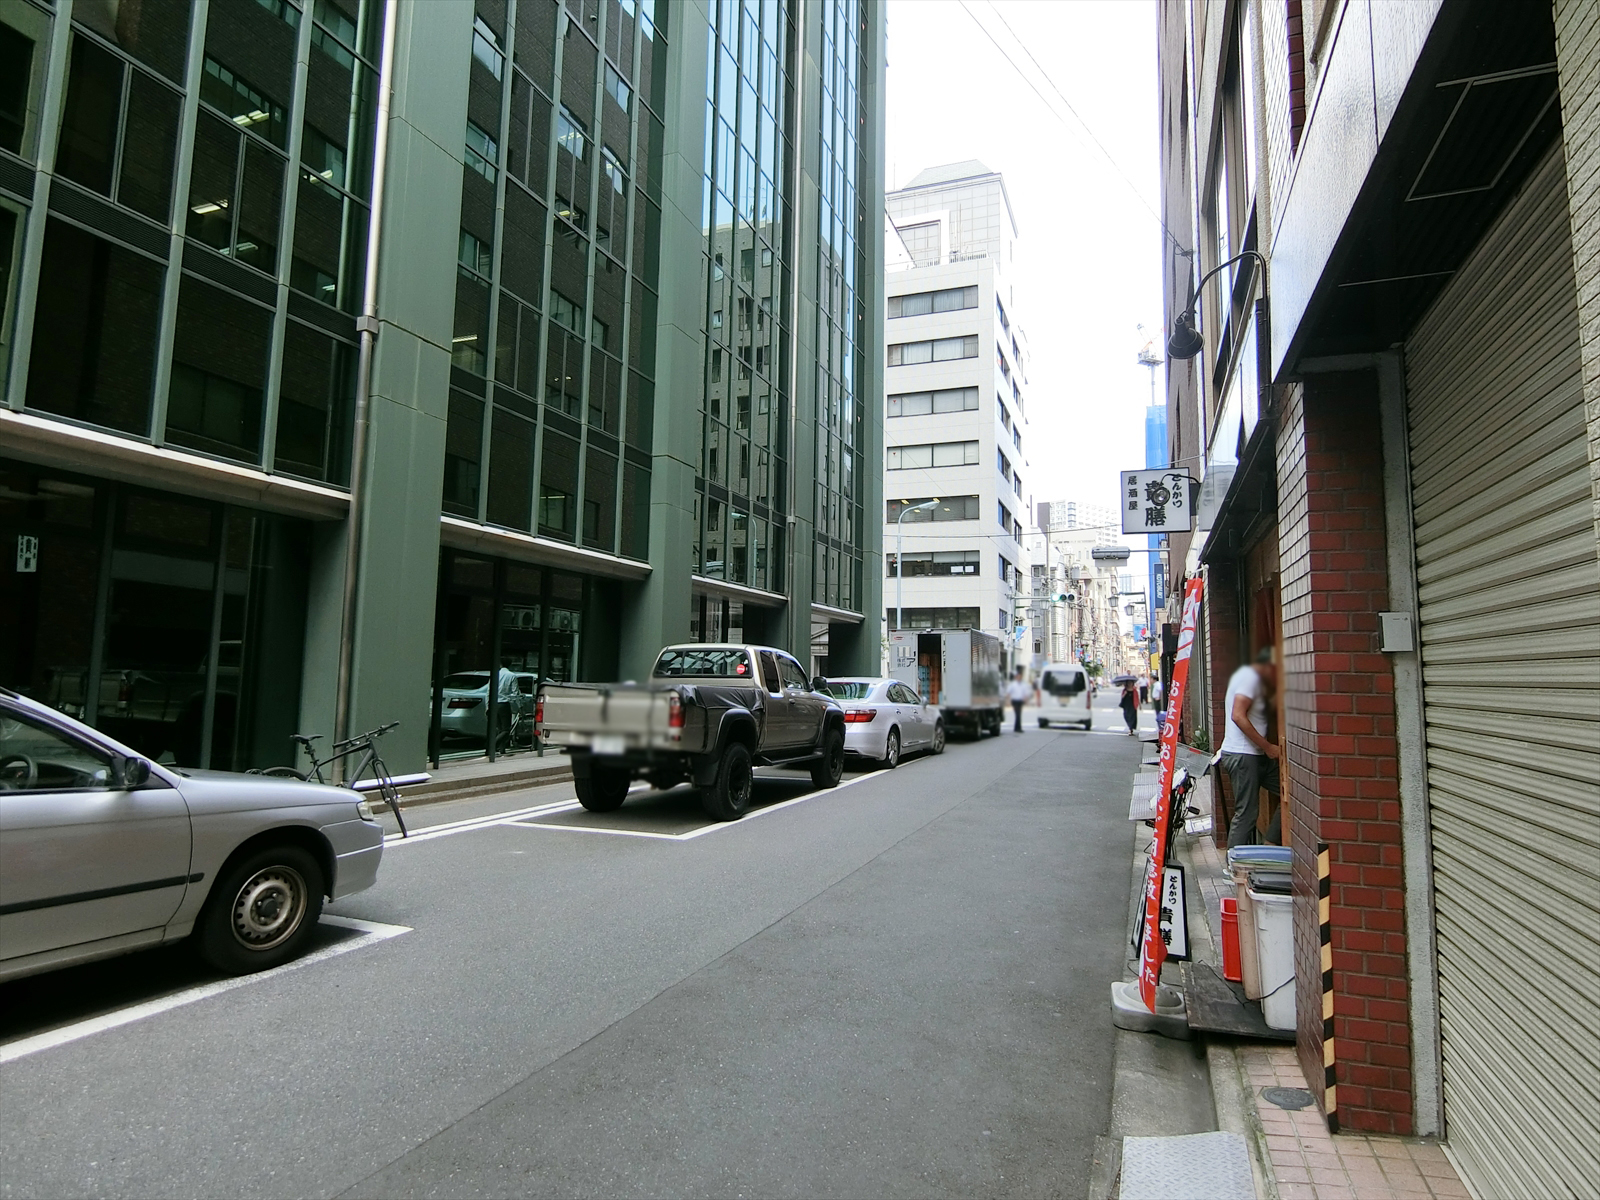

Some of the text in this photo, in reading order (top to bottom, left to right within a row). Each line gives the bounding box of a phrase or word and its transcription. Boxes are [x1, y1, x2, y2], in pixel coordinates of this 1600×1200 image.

[1127, 475, 1138, 511] 居酒屋
[1168, 875, 1178, 905] とんかつ
